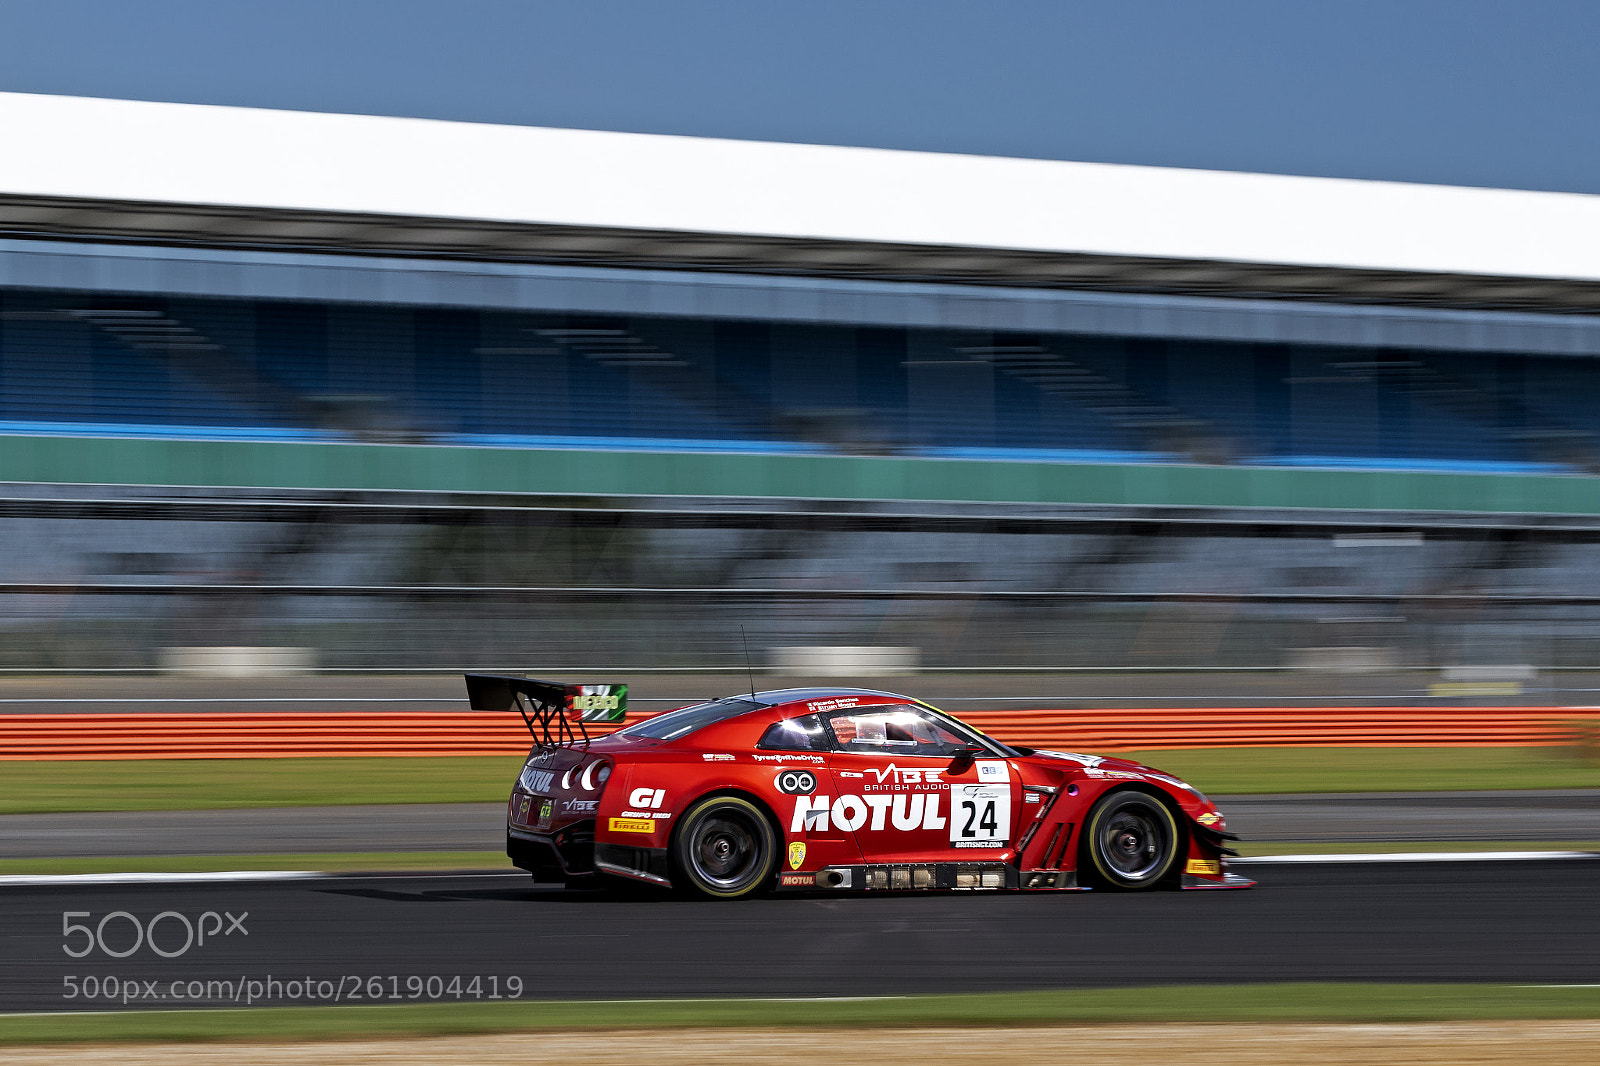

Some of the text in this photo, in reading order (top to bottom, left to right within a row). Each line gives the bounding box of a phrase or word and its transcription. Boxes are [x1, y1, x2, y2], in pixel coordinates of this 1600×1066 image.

[862, 762, 950, 784] VIBE
[562, 797, 600, 810] VIBE
[629, 787, 666, 809] GI
[790, 793, 947, 833] MOTUL
[961, 800, 998, 838] 24
[614, 820, 650, 830] PIRELLI
[783, 876, 814, 885] MOTUL
